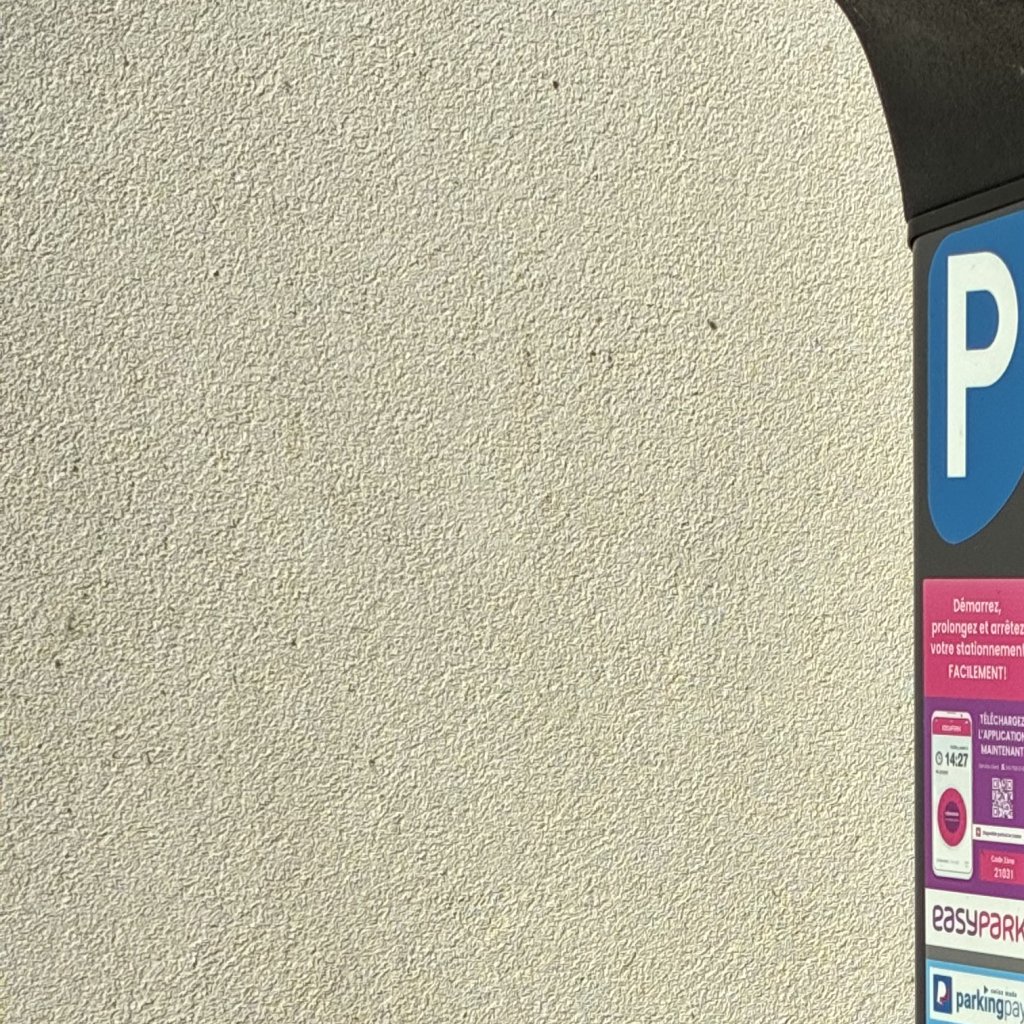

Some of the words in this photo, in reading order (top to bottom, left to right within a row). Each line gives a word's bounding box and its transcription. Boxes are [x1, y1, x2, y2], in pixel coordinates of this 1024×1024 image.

[947, 251, 1018, 478] P
[953, 597, 1001, 615] Démarrez,
[932, 619, 977, 638] prolongez
[979, 621, 989, 634] et
[990, 619, 1024, 635] arrêtez
[930, 641, 954, 655] votre
[948, 664, 1007, 680] FACILEMENT!
[980, 744, 1024, 757] MAINTENANT
[945, 752, 968, 767] 14:27
[993, 867, 1014, 880] 21031
